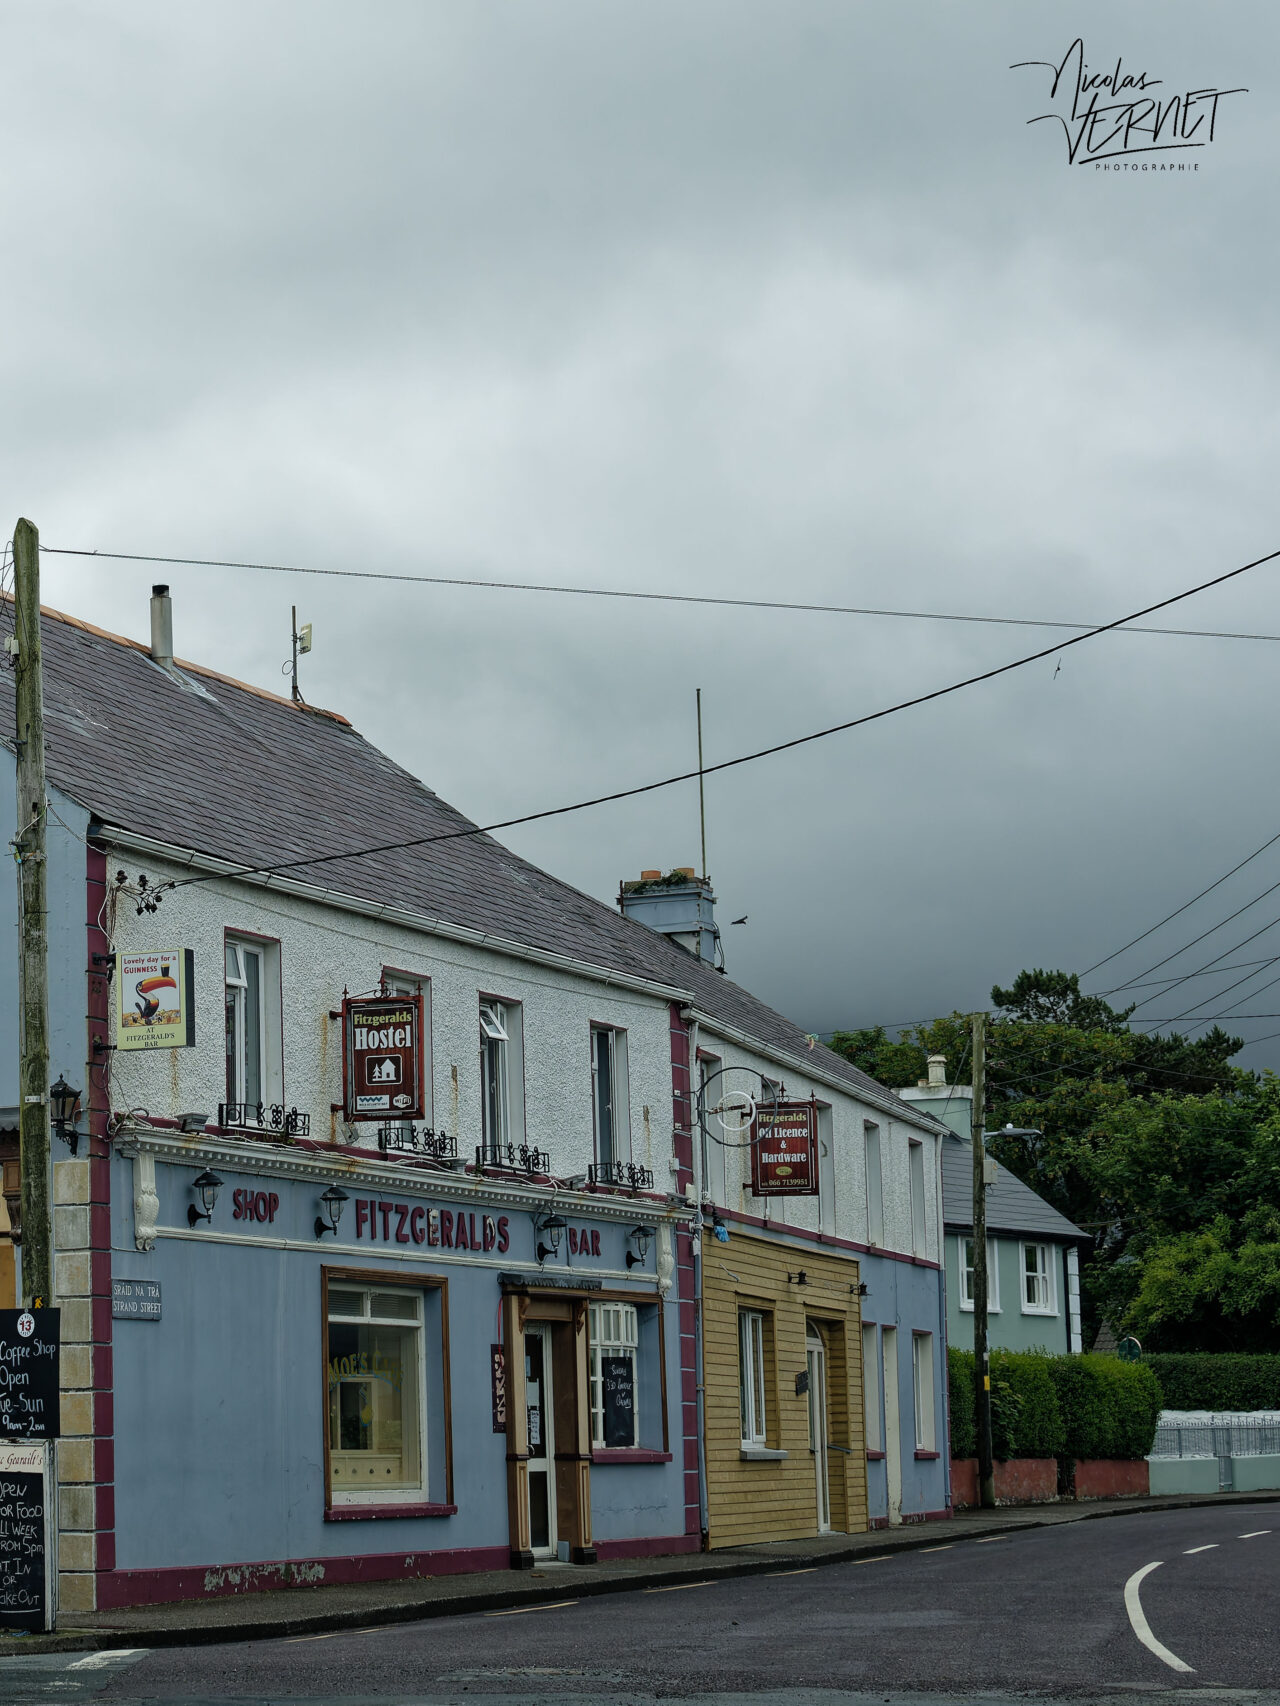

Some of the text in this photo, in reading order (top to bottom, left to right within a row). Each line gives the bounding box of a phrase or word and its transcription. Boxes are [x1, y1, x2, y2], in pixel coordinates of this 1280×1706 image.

[124, 957, 145, 965] Lovely
[147, 956, 159, 964] day
[124, 966, 158, 974] GUINNESS
[354, 1011, 412, 1026] Fitzgeralds
[126, 1033, 175, 1042] FITZGERALD'S
[354, 1025, 412, 1050] Hostel
[144, 1040, 158, 1048] BAR
[774, 1127, 808, 1139] Licence
[780, 1140, 787, 1149] &
[762, 1153, 807, 1164] Hardware
[232, 1188, 280, 1223] SHOP
[568, 1227, 602, 1256] BAR
[135, 1285, 145, 1297] NA
[113, 1301, 161, 1313] STRAND STREET
[20, 1320, 32, 1332] 13
[0, 1338, 56, 1367] Coffee Shop
[17, 1502, 43, 1519] FOOD
[11, 1521, 38, 1538] WEEK
[23, 1536, 45, 1557] 5pm
[2, 1575, 17, 1586] OR
